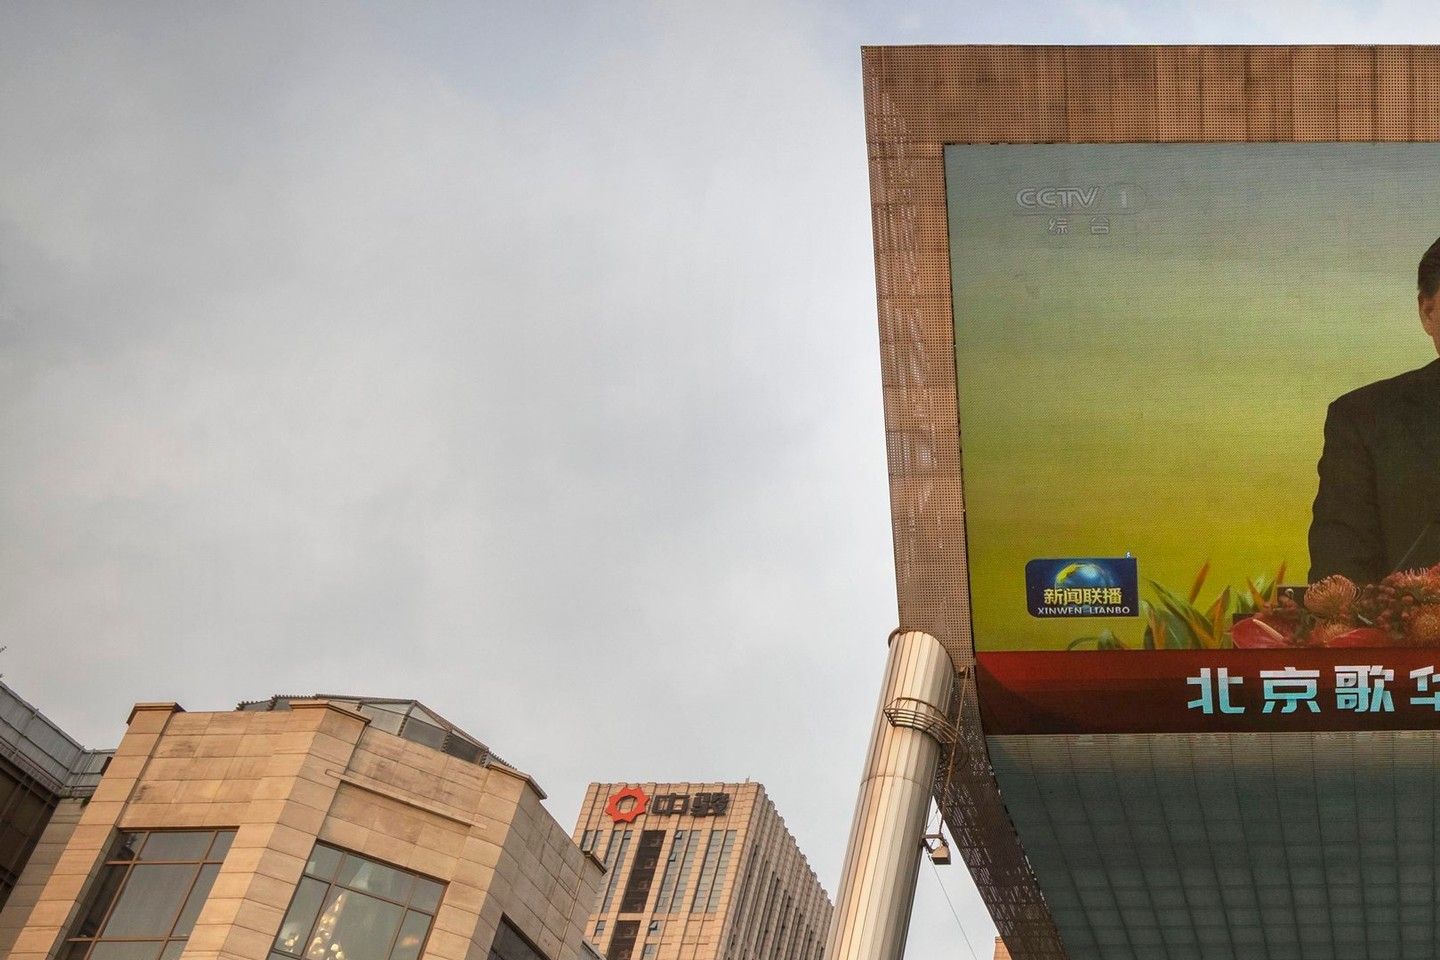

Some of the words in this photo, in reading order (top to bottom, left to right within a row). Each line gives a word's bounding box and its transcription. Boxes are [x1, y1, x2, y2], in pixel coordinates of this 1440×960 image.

[1016, 187, 1100, 209] CCTV
[1048, 217, 1110, 235] 综合
[1043, 587, 1122, 606] 新闻联播
[1038, 607, 1082, 616] XINWEN
